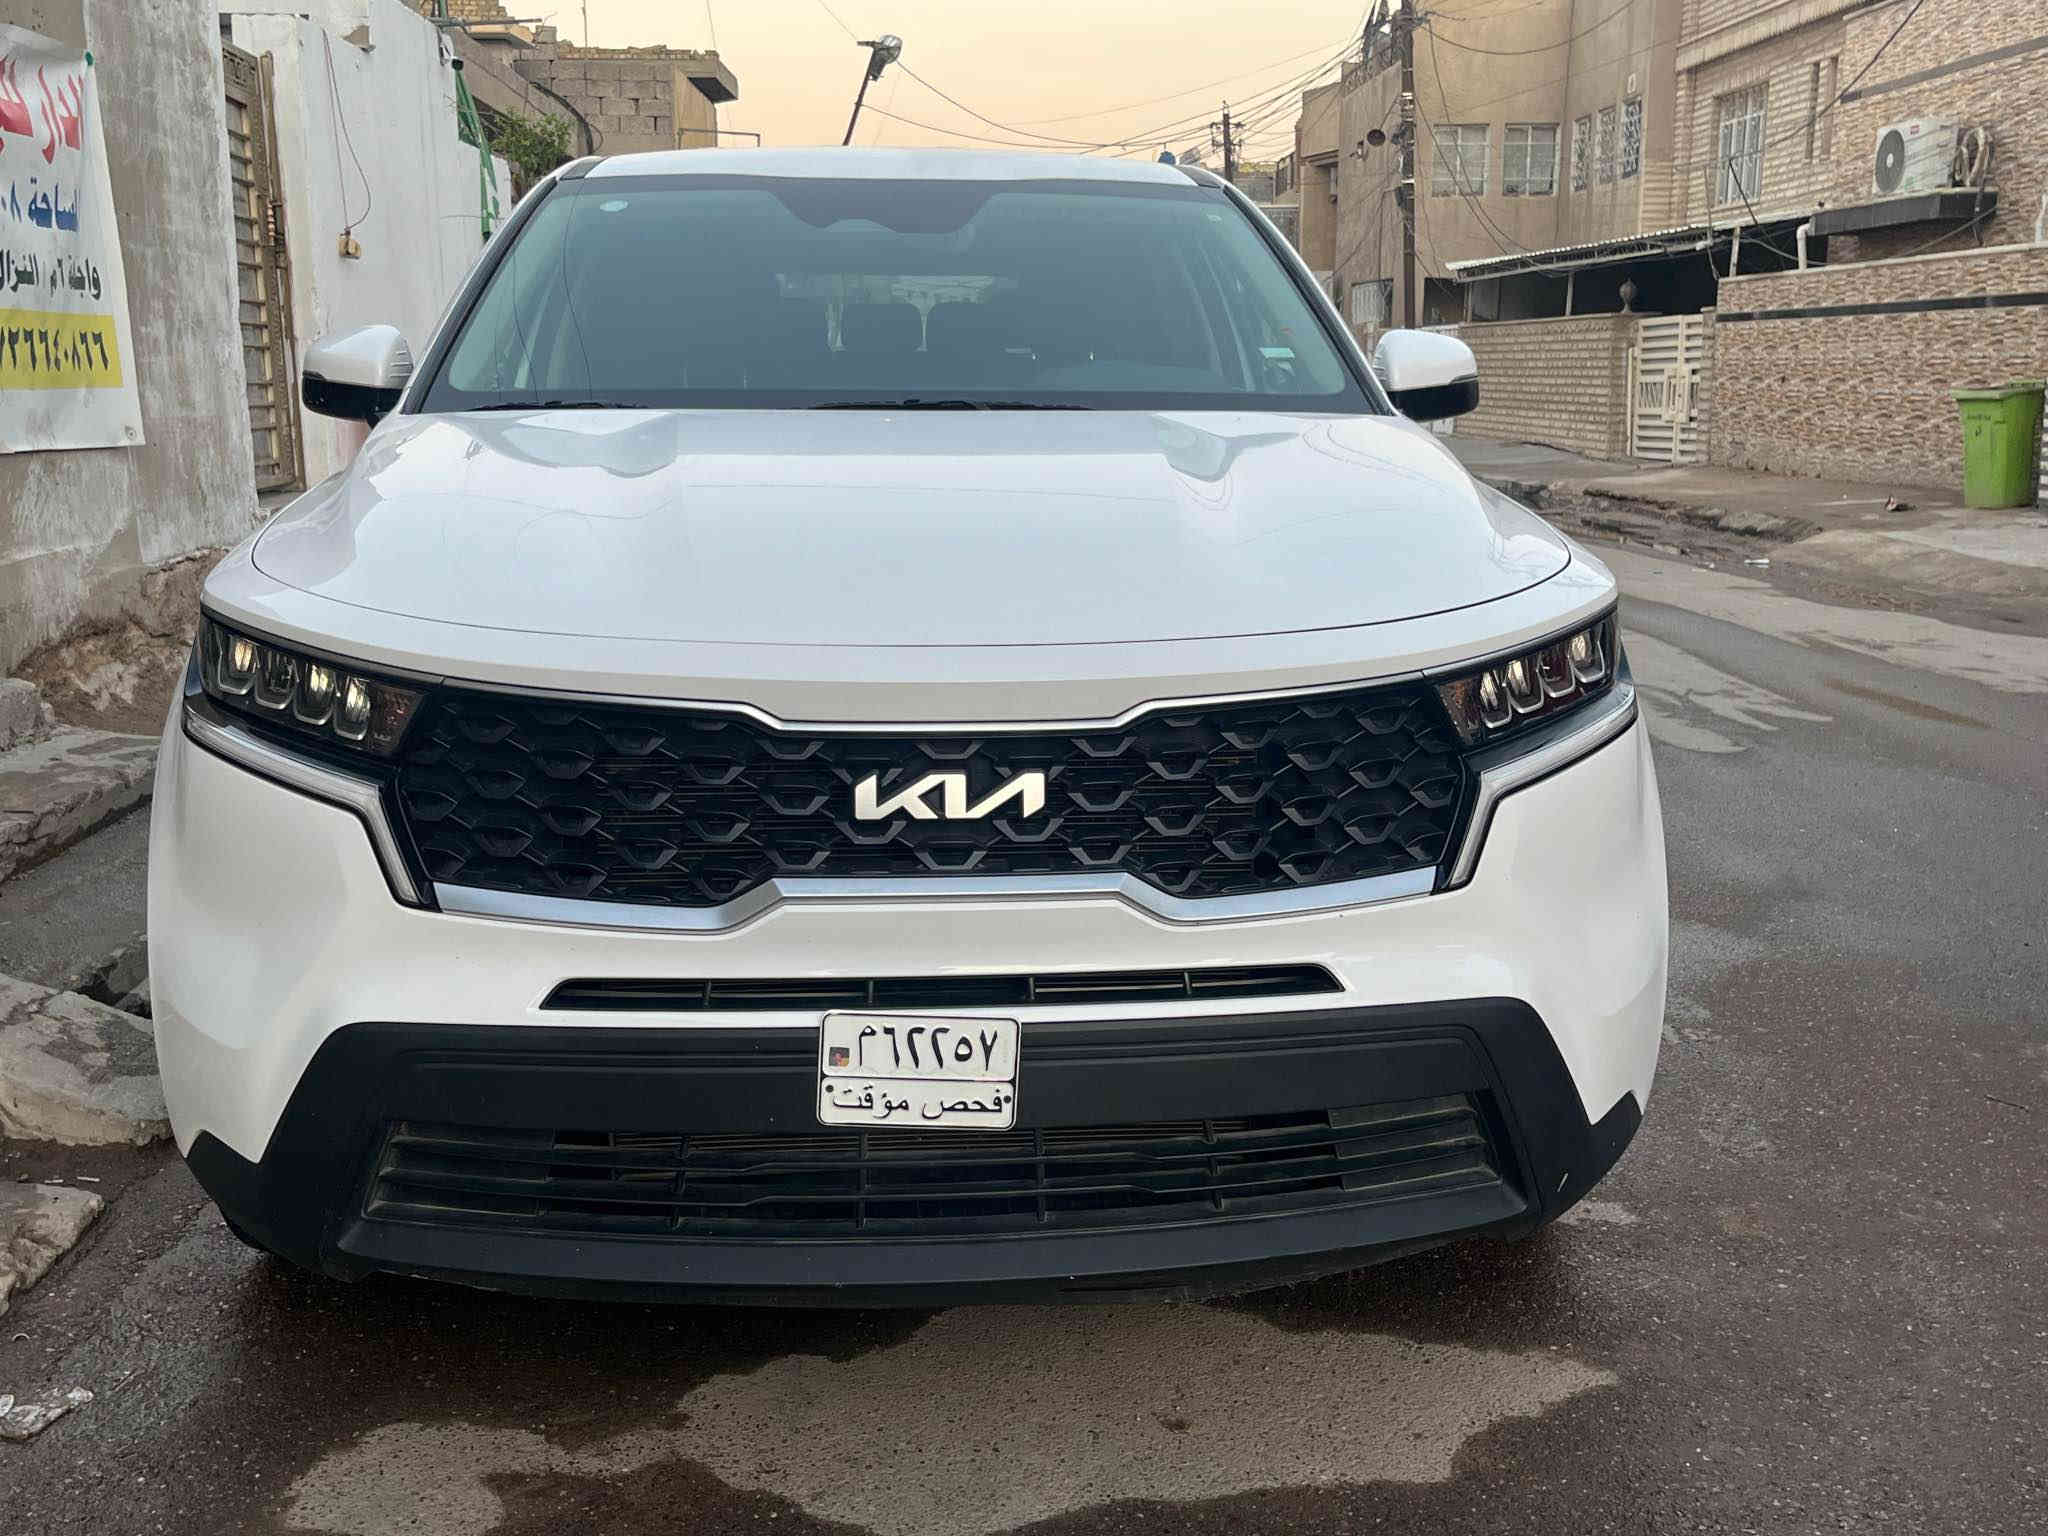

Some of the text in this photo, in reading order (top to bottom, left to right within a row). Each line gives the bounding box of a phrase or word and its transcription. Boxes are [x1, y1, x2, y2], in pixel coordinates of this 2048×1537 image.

[39, 64, 85, 165] الدار
[855, 773, 1045, 820] KIA
[832, 1081, 1003, 1120] فحص مؤقت
